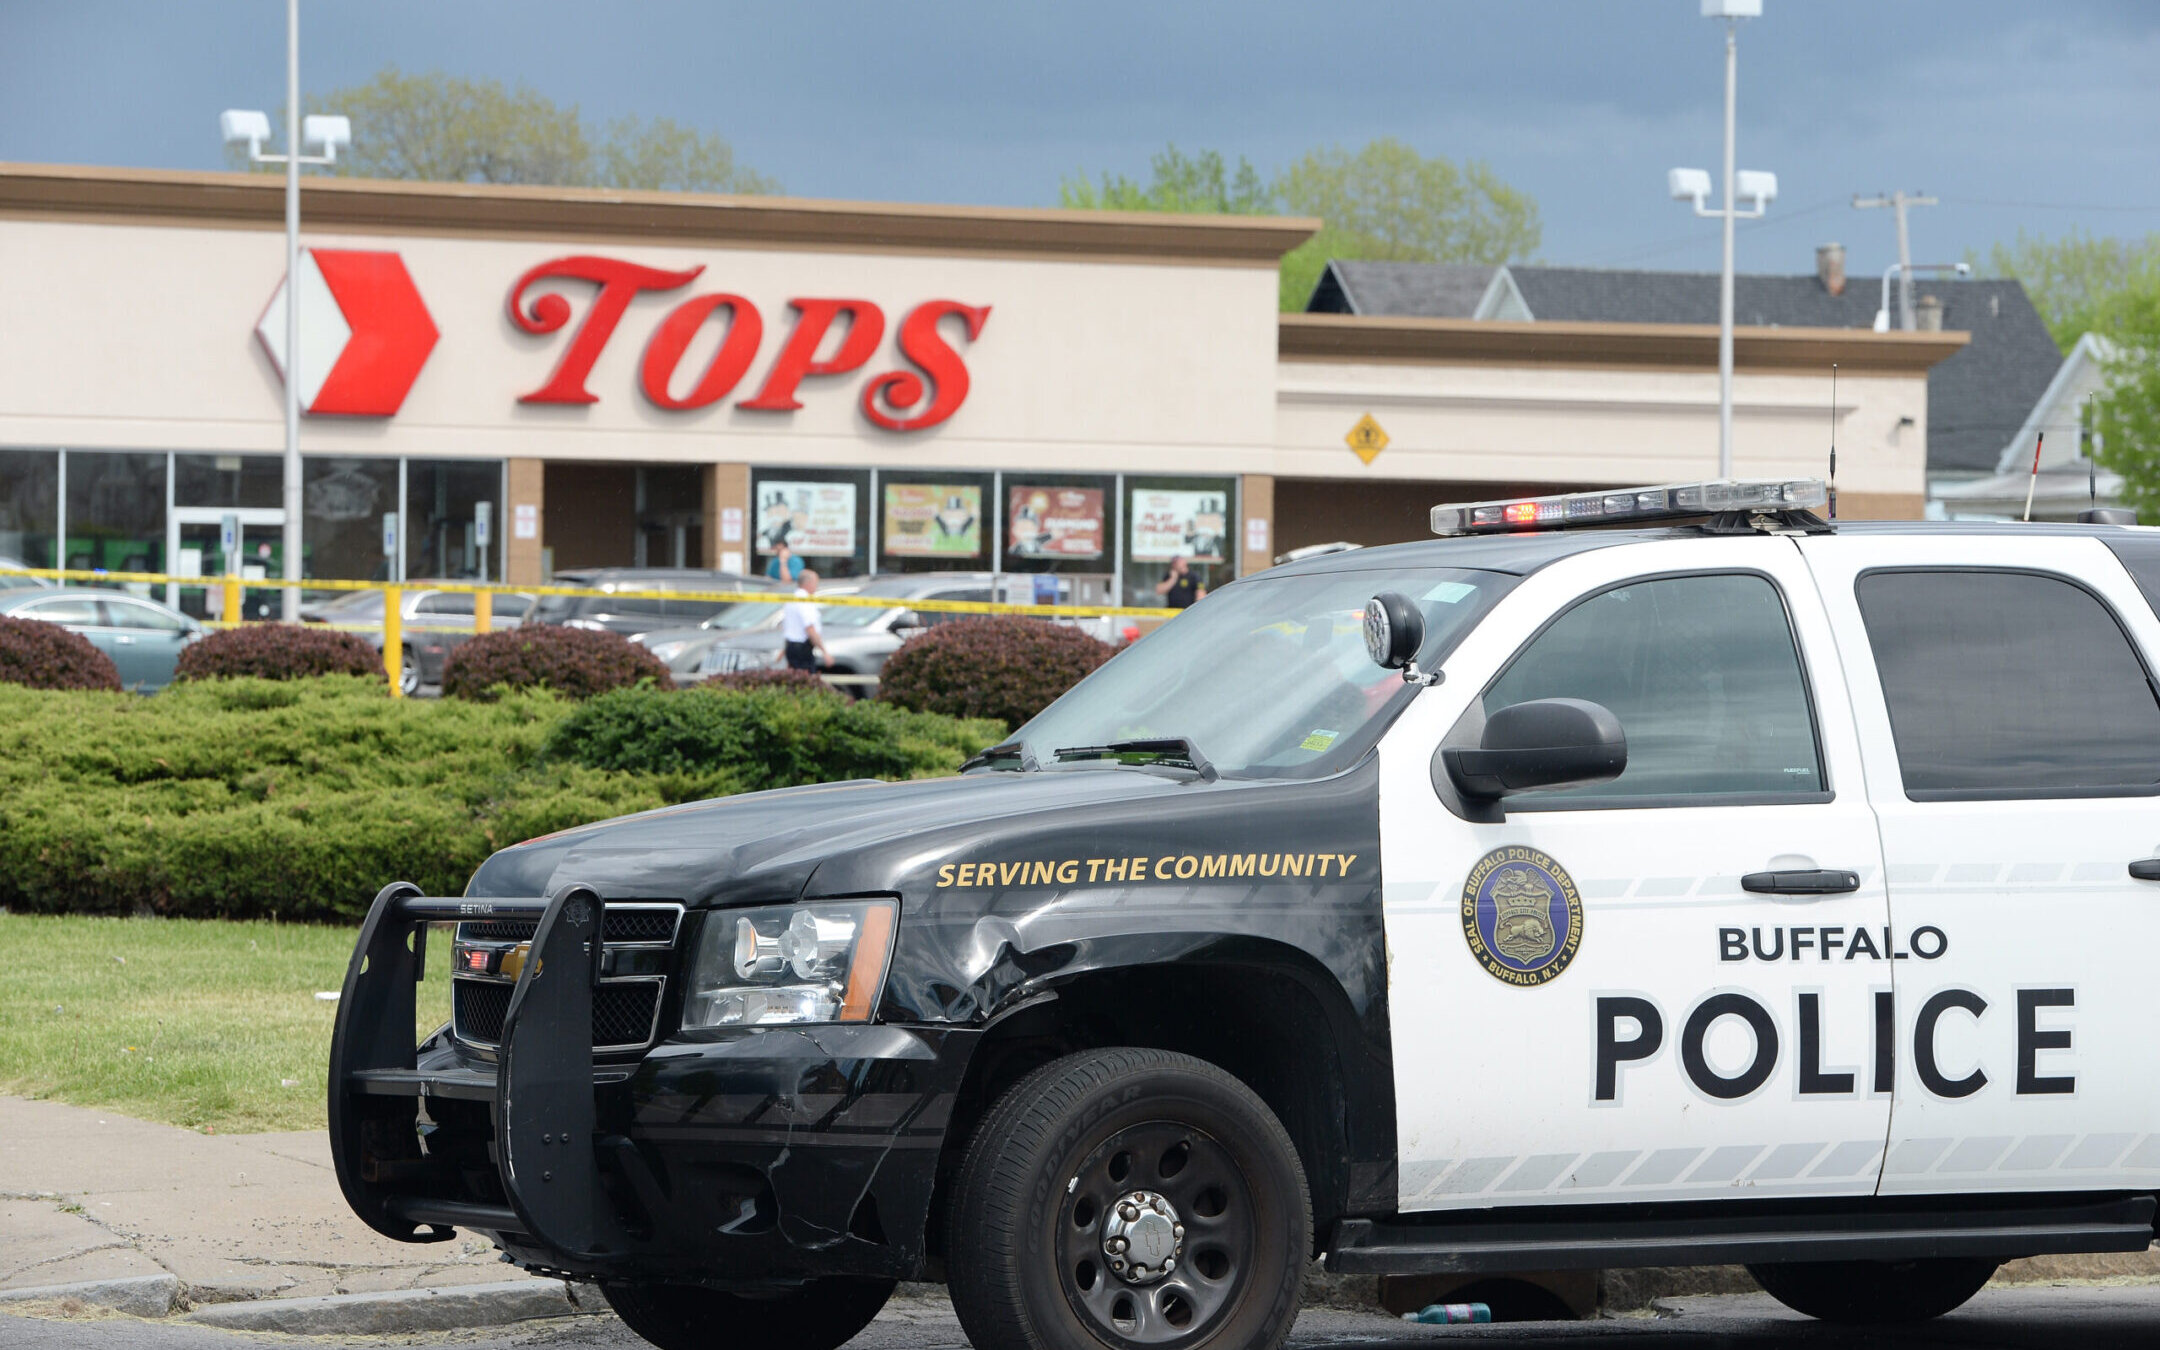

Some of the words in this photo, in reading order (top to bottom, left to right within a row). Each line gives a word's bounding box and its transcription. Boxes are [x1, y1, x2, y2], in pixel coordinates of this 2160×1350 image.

[936, 860, 1079, 888] SERVING
[1086, 857, 1148, 883] THE
[1154, 853, 1358, 881] COMMUNITY
[1466, 851, 1506, 895] BUFFALO
[1508, 848, 1551, 869] POLICE
[460, 904, 493, 914] SETINA
[1463, 898, 1474, 917] OF
[1551, 865, 1582, 954] DEPARTMENT
[1465, 920, 1484, 955] SEAL
[1719, 926, 1948, 962] BUFFALO
[1487, 961, 1541, 986] BUFFALO,
[1543, 961, 1564, 980] N.Y.
[1595, 987, 2075, 1101] POLICE
